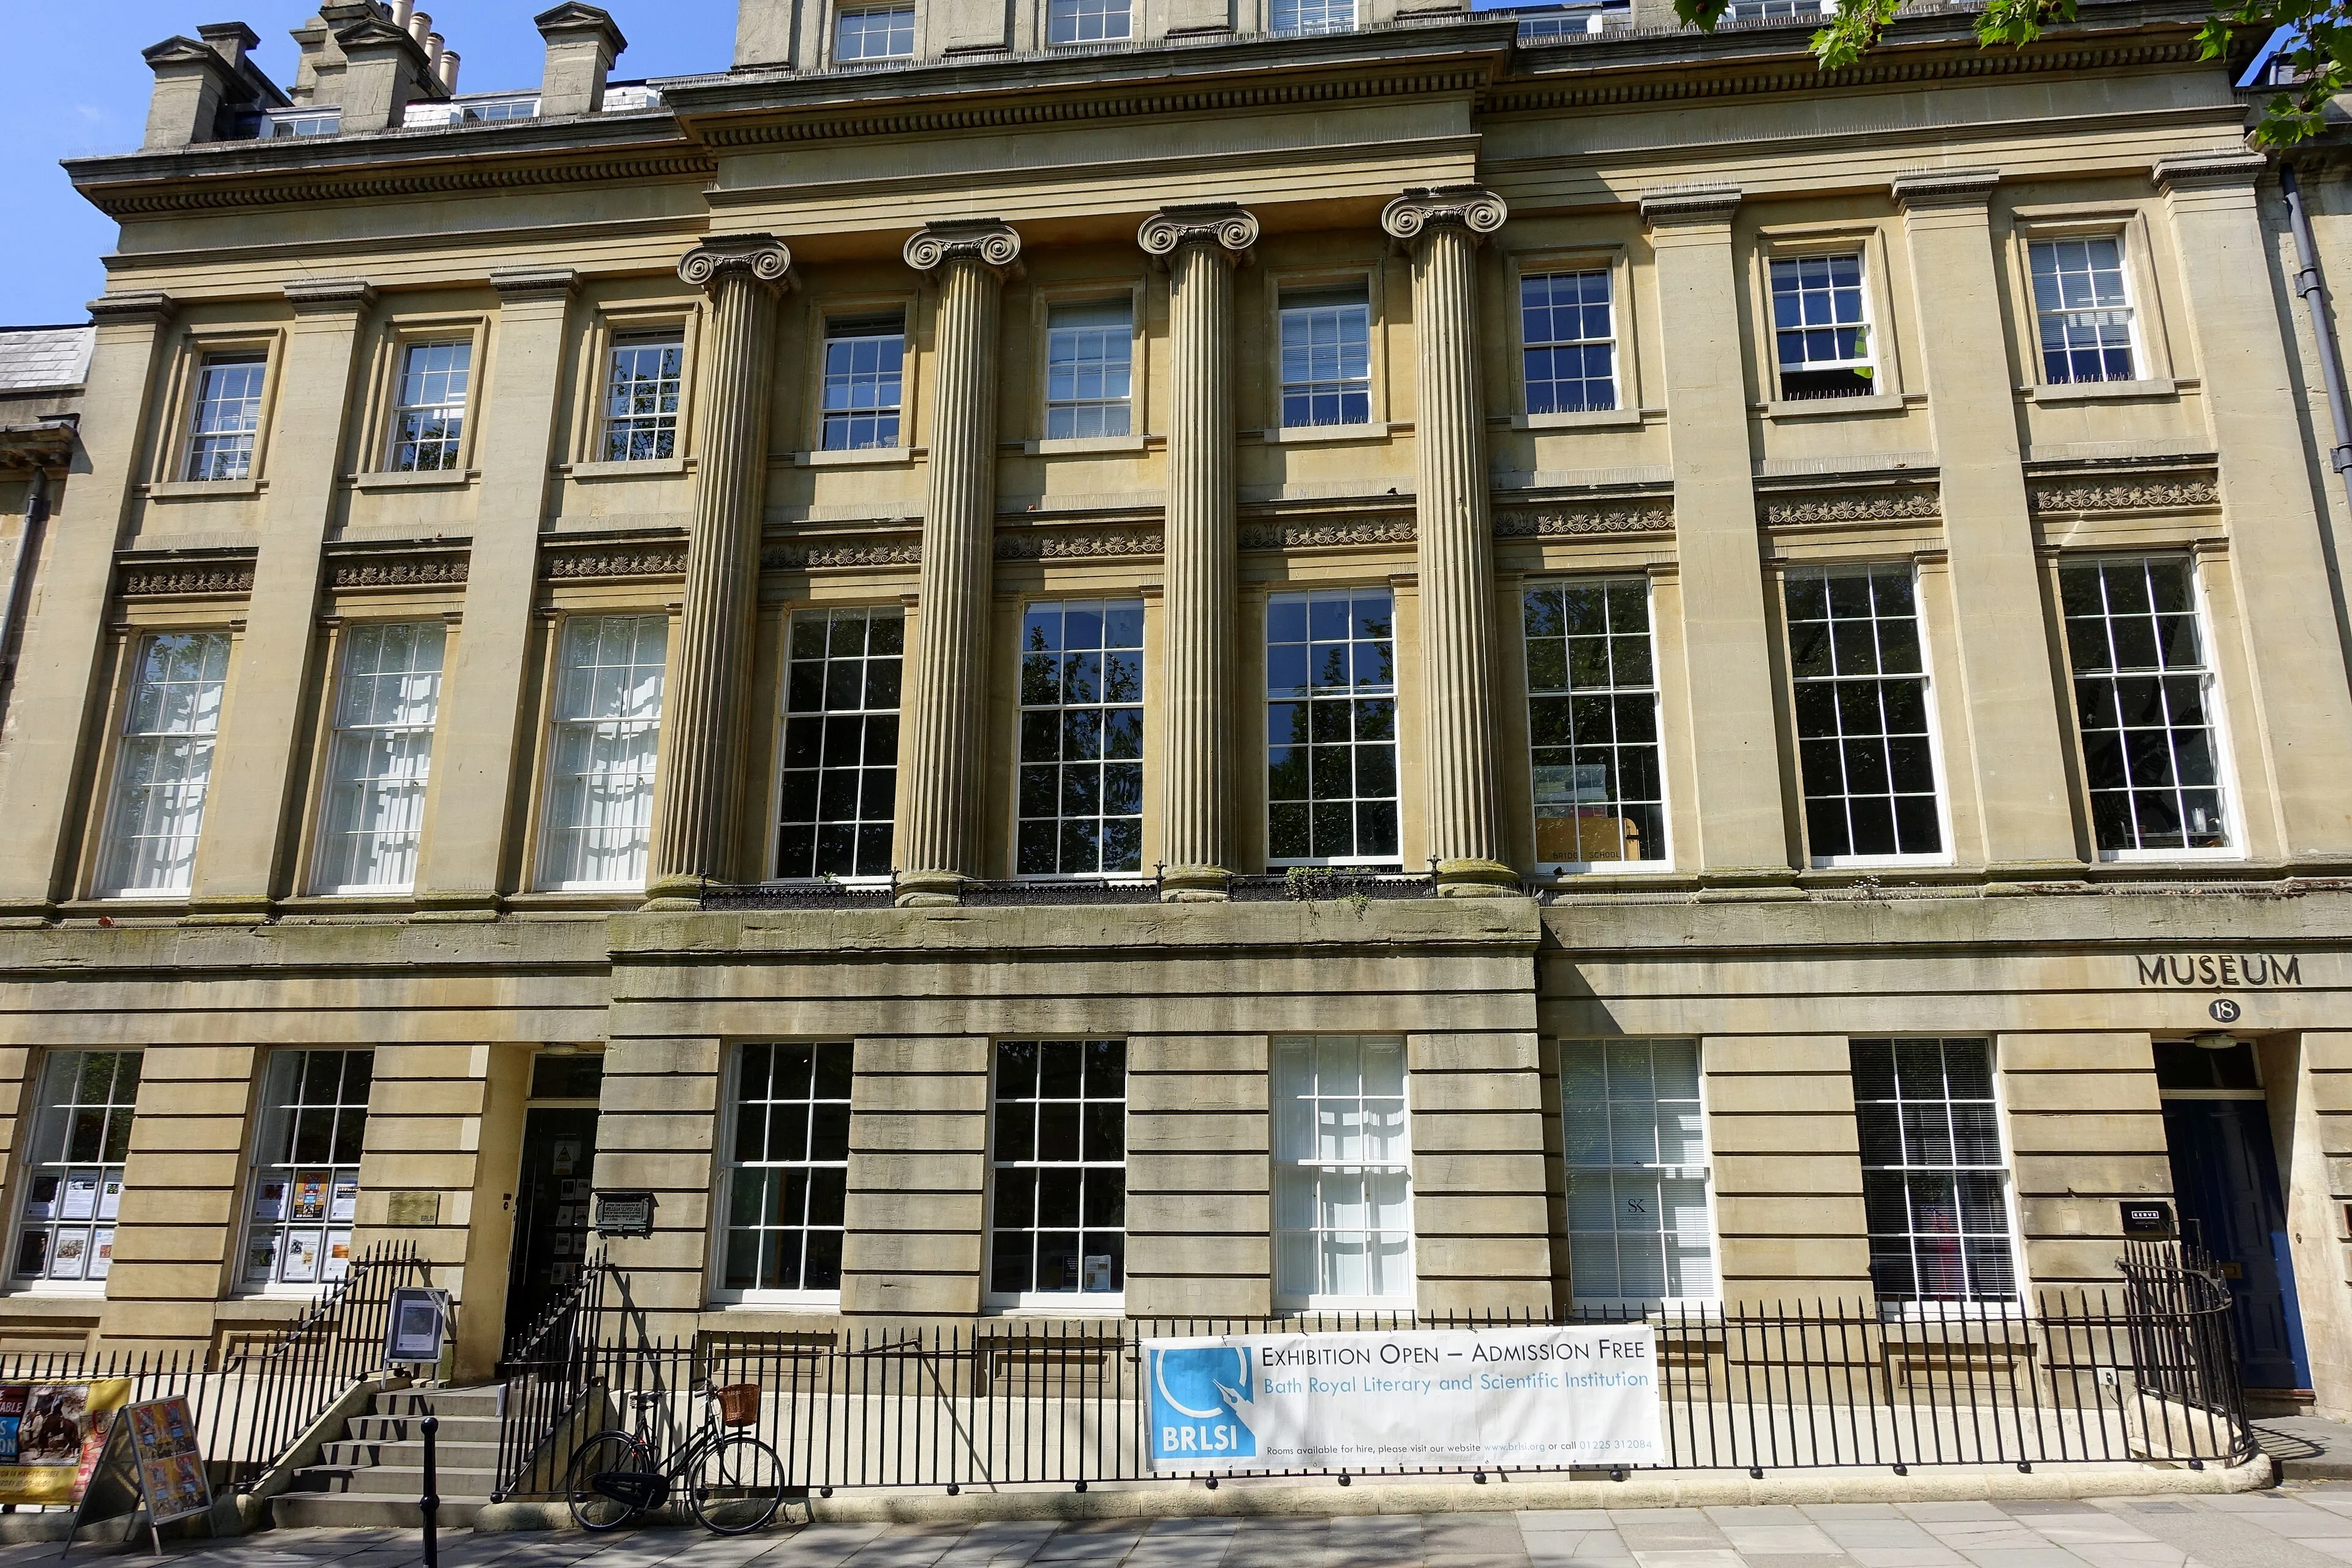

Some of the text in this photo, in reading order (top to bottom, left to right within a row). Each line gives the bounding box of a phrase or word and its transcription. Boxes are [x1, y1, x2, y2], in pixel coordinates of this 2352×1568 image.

[2136, 955, 2302, 986] MUSEUM
[2215, 1001, 2234, 1019] 18
[1628, 1199, 1646, 1213] SK
[431, 1292, 444, 1311] Tonight!
[1262, 1347, 1371, 1366] EXHIBITION
[1380, 1344, 1439, 1364] OPEN
[1472, 1343, 1589, 1362] ADMISSION
[1599, 1339, 1645, 1359] FREE
[1264, 1371, 1648, 1396] Bath Royal Literary and Scientific Institution
[1163, 1425, 1237, 1452] BRLSI
[1267, 1446, 1294, 1455] Rooms
[1297, 1445, 1338, 1454] available
[1341, 1444, 1353, 1453] for
[1357, 1444, 1376, 1454] hire,
[1378, 1445, 1407, 1454] please
[1411, 1444, 1427, 1452] visit
[1447, 1443, 1480, 1452] website
[1484, 1442, 1545, 1452] www.brlsi.org
[1561, 1441, 1576, 1450] call
[1580, 1440, 1610, 1449] 01225
[1615, 1439, 1652, 1449] 312084
